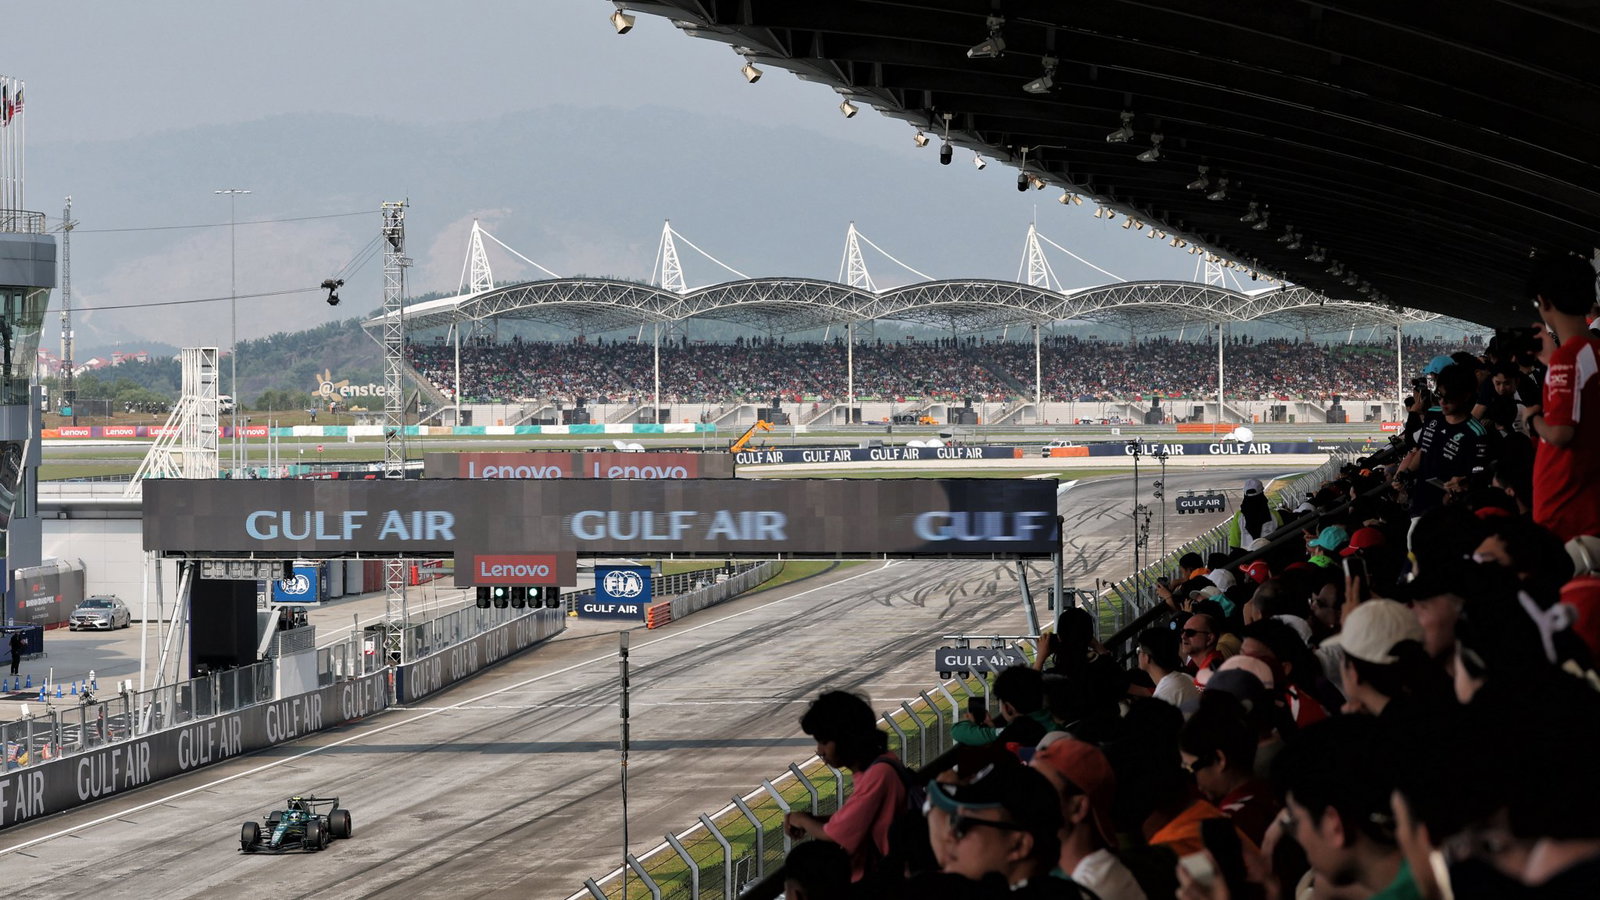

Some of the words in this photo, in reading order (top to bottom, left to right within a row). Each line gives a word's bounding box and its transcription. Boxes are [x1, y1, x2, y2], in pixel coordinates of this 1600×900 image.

[60, 428, 88, 436] Lenovo
[106, 428, 133, 436] Lenovo
[803, 451, 830, 462] GULF
[834, 450, 851, 461] AIR
[871, 449, 900, 460] GULF
[903, 448, 920, 460] AIR
[937, 448, 964, 459] GULF
[966, 448, 982, 458] AIR
[1162, 444, 1184, 455] AIR
[1209, 444, 1244, 455] GULF
[1248, 443, 1272, 454] AIR
[736, 453, 763, 464] GULF
[766, 452, 783, 463] AIR
[468, 462, 562, 478] Lenovo
[594, 462, 688, 478] Lenovo
[1181, 500, 1204, 508] GULF
[246, 510, 368, 540] GULF
[378, 510, 456, 540] AIR
[570, 510, 698, 540] GULF
[705, 510, 788, 540] AIR
[913, 511, 1048, 541] GULF
[481, 562, 550, 576] Lenovo
[605, 576, 640, 591] FIA
[584, 604, 614, 613] GULF
[618, 604, 638, 614] AIR
[451, 646, 467, 680] GULF
[944, 655, 985, 666] GULF
[411, 662, 429, 698] GULF
[430, 657, 442, 690] AIR
[343, 680, 372, 720] GULF
[373, 674, 388, 712] AIR
[266, 698, 300, 743] GULF
[302, 693, 322, 733] AIR
[178, 722, 216, 770] GULF
[218, 715, 242, 758] AIR
[77, 750, 121, 800] GULF
[124, 740, 150, 788] AIR
[14, 770, 45, 822] AIR
